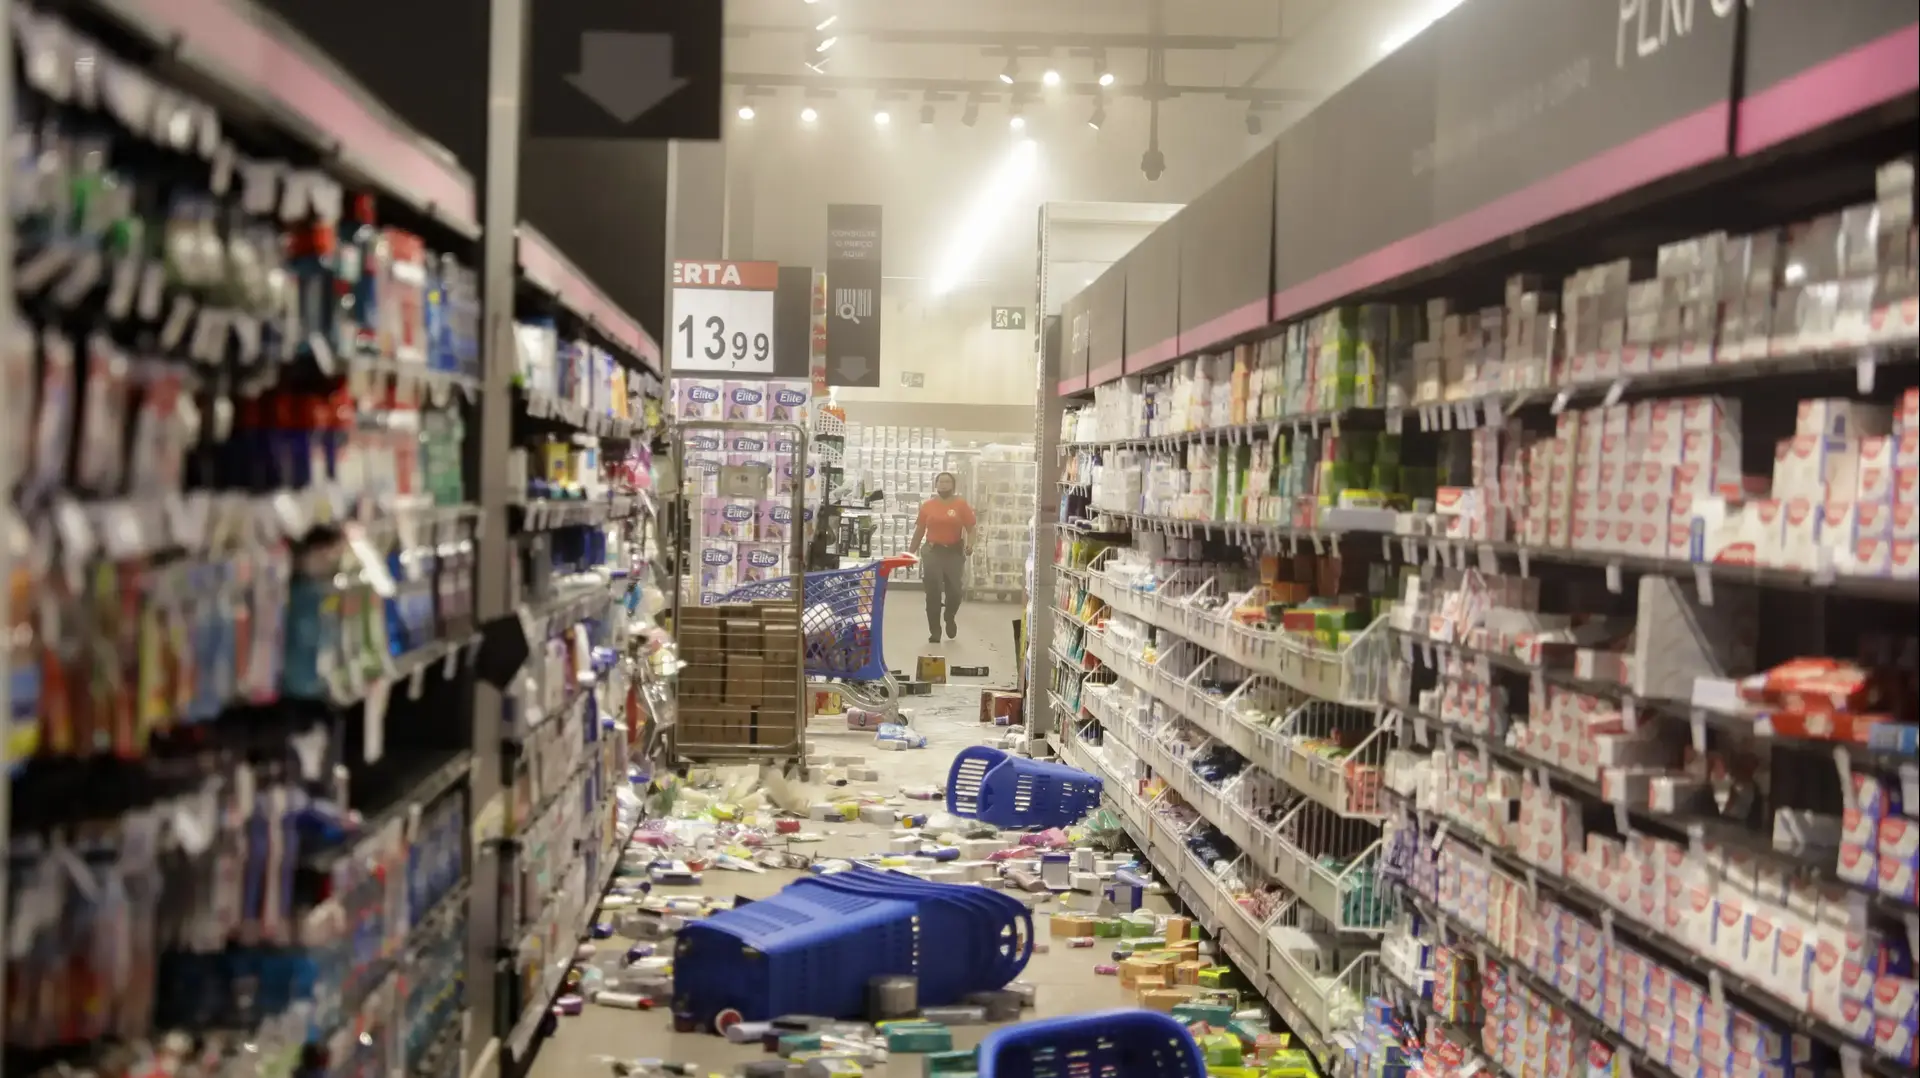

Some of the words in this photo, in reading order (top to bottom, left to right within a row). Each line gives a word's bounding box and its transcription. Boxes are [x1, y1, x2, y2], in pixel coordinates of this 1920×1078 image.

[831, 230, 877, 238] CONSULTE
[679, 314, 769, 369] 13,99
[692, 388, 715, 400] Elite
[736, 391, 758, 402] Elite
[780, 393, 803, 403] Elite
[737, 440, 760, 450] Elite
[727, 507, 749, 518] Elite
[705, 551, 728, 562] Elite
[751, 553, 775, 564] Elite
